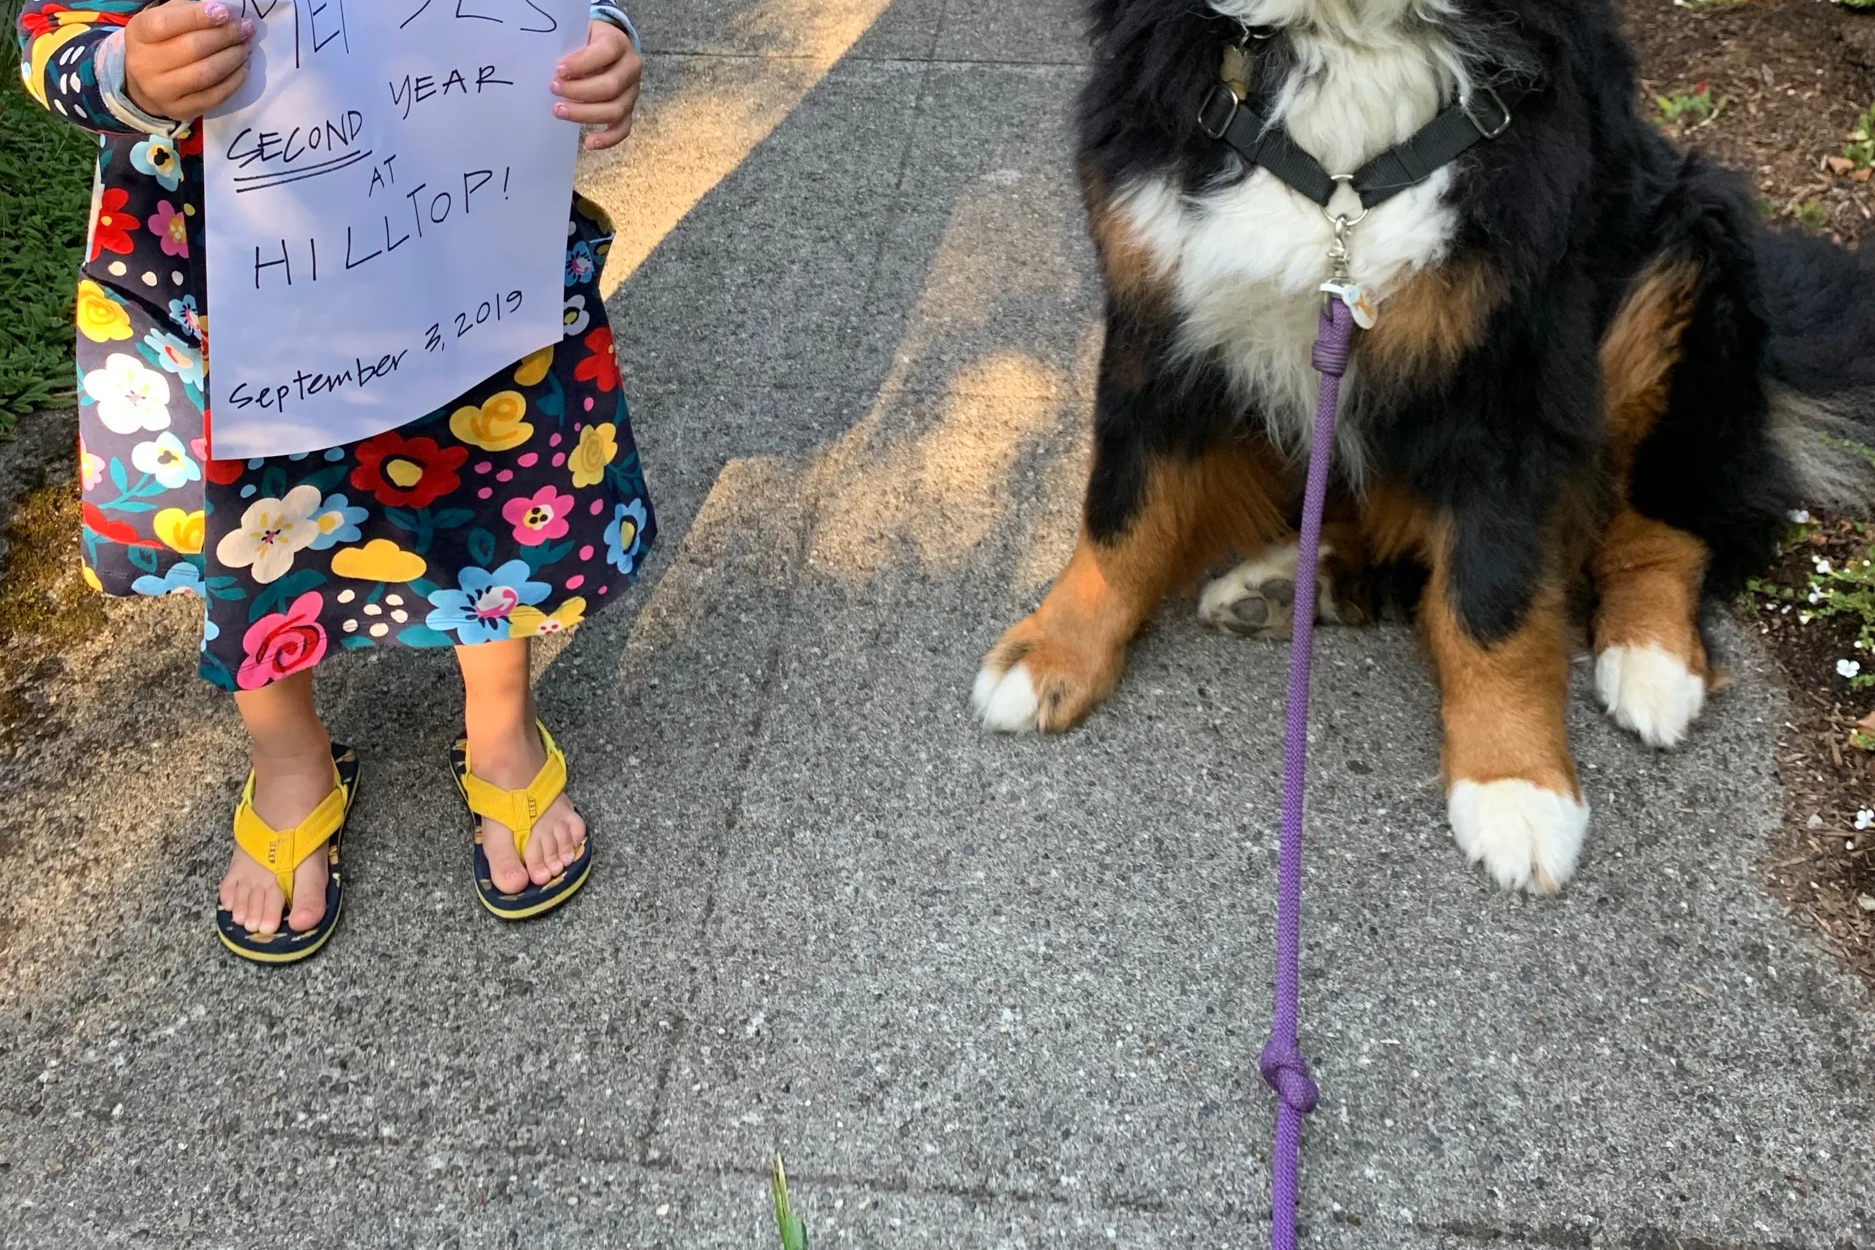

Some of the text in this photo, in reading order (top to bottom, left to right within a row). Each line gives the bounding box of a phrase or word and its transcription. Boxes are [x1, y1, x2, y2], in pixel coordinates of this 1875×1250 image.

[226, 65, 514, 168] SECOND YEAR
[254, 166, 511, 289] HILLTOP!
[368, 154, 397, 198] AT
[228, 290, 523, 413] September 3, 2019
